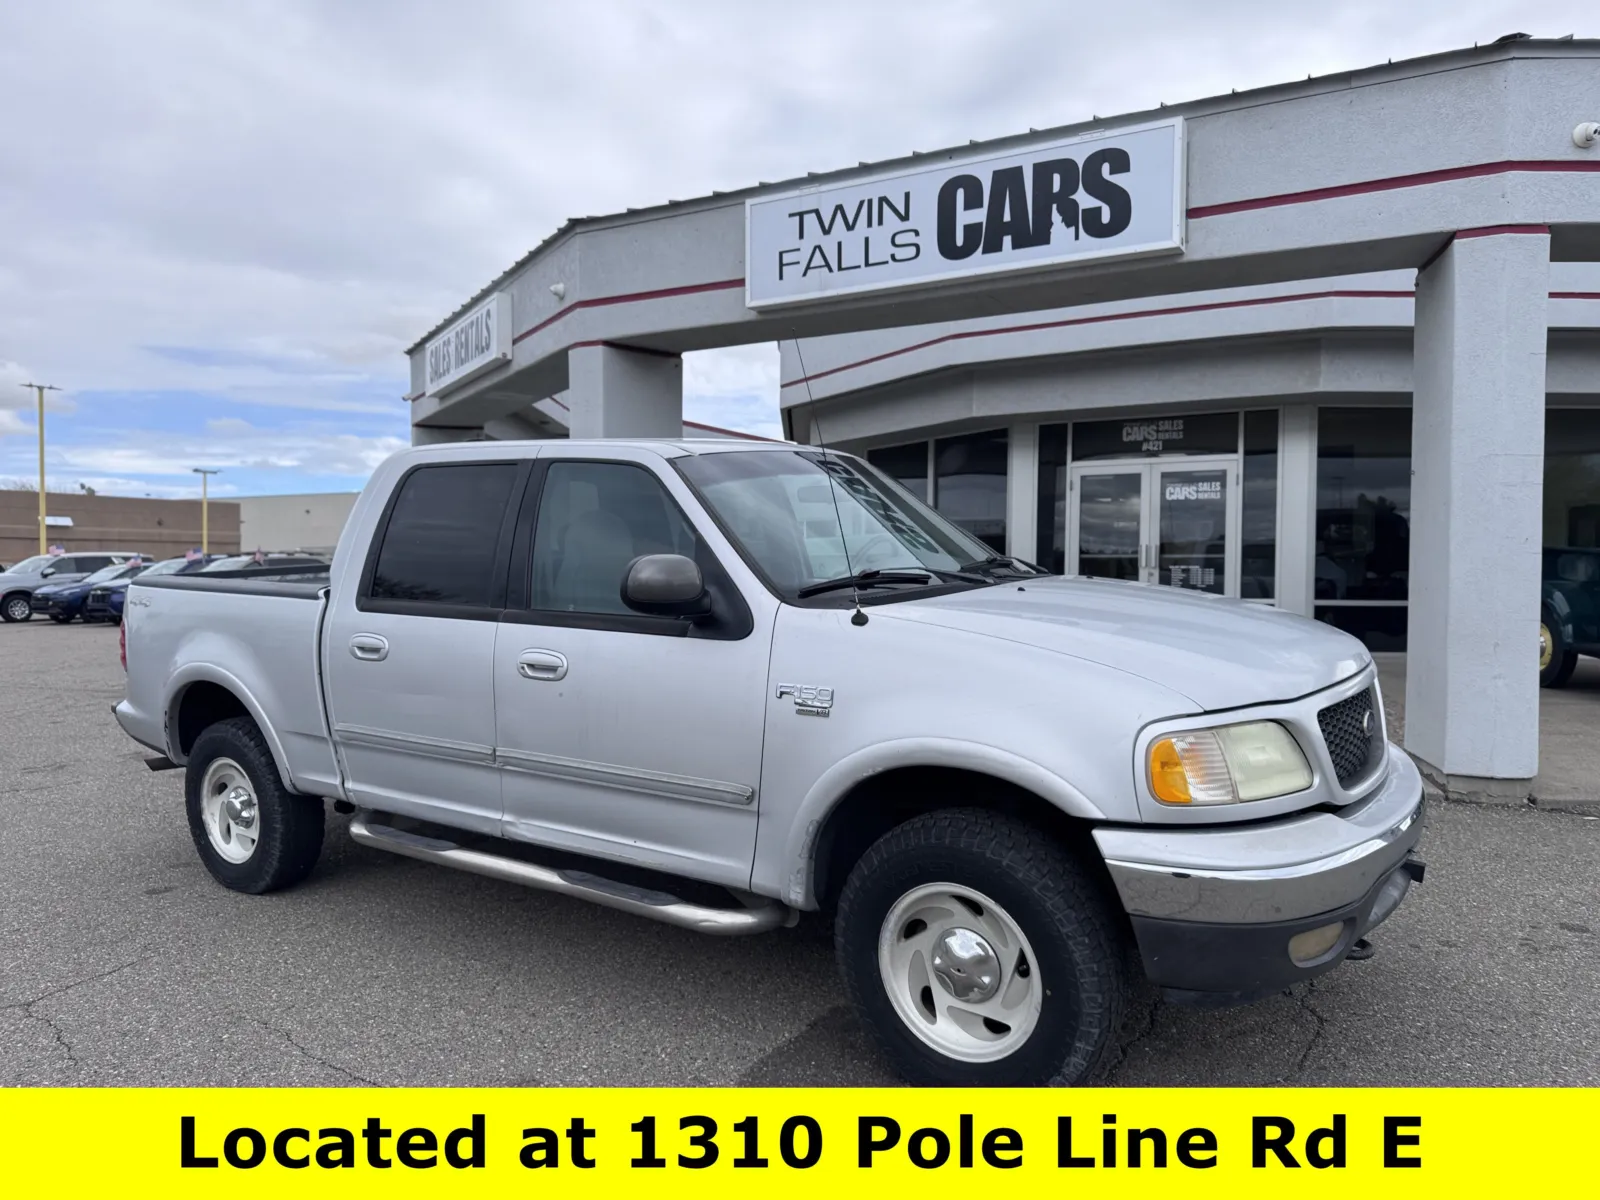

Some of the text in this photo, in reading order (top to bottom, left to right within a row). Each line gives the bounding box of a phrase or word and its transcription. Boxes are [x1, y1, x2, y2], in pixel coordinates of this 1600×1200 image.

[936, 147, 1133, 261] CARS
[788, 191, 911, 240] TWIN
[778, 228, 921, 281] FALLS
[429, 308, 491, 385] SALES RENTALS
[1122, 425, 1157, 442] CARS
[1158, 419, 1184, 431] SALES
[1141, 440, 1163, 452] #421
[1165, 485, 1197, 500] CARS
[1198, 481, 1221, 491] SALES
